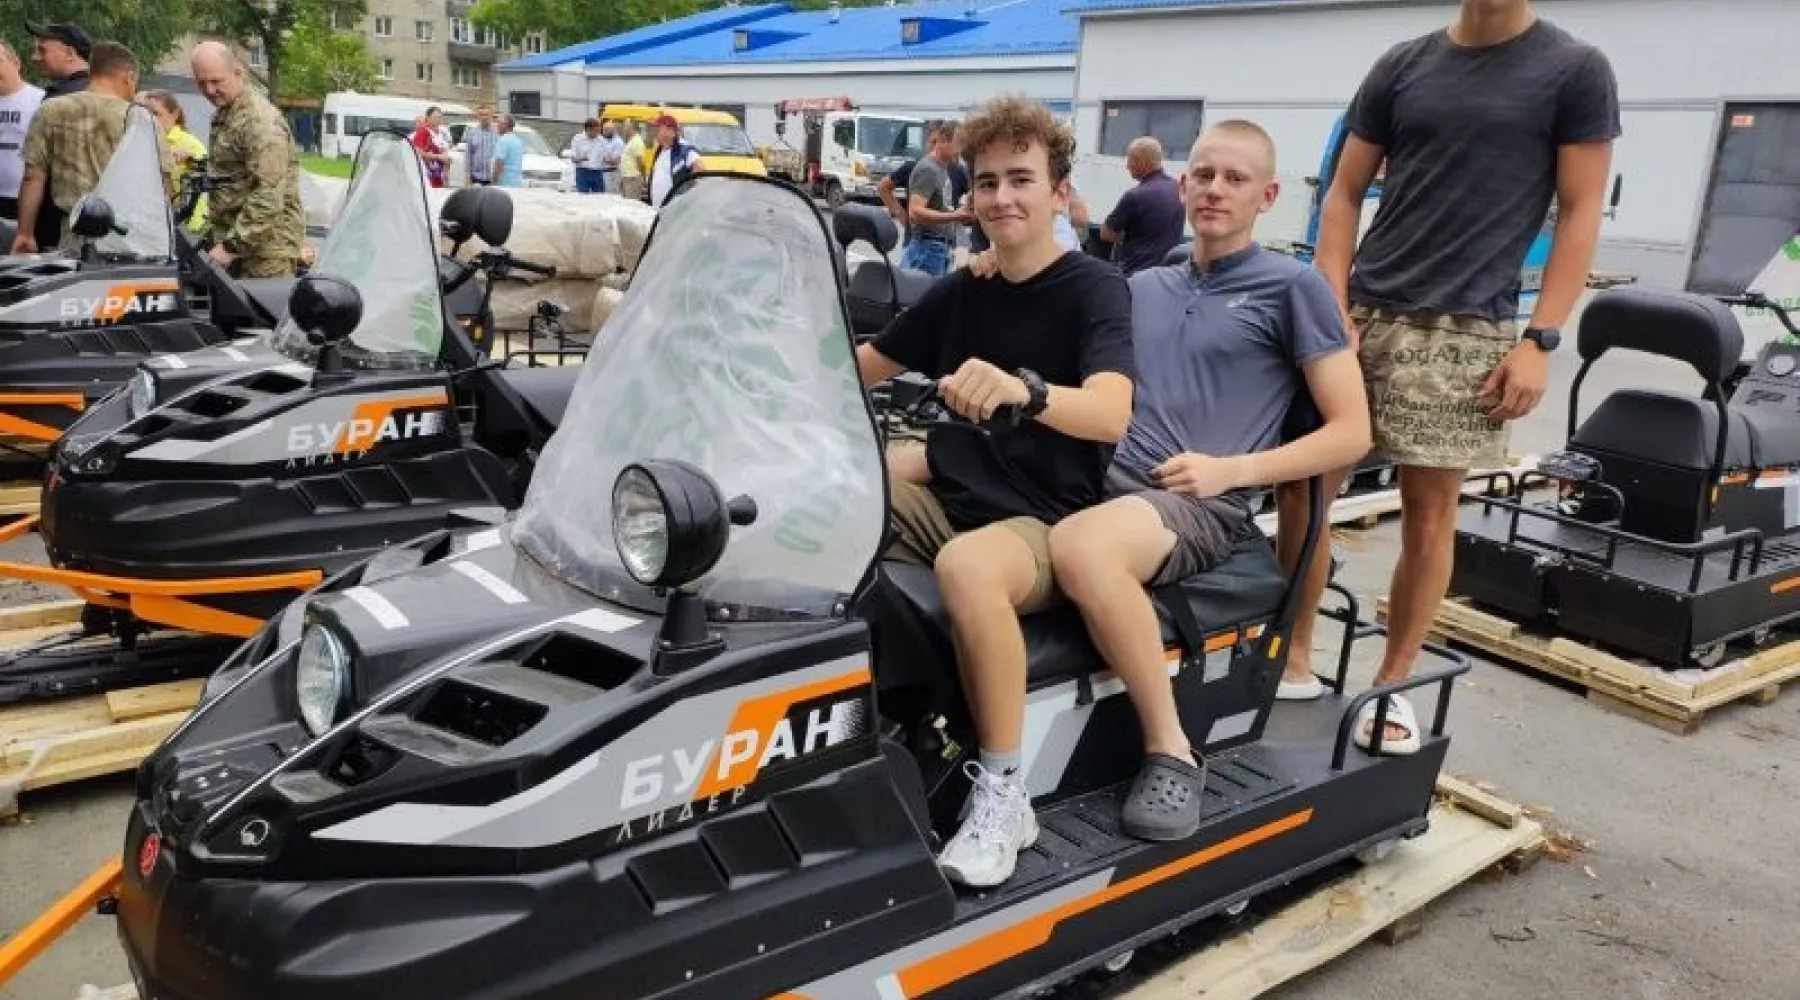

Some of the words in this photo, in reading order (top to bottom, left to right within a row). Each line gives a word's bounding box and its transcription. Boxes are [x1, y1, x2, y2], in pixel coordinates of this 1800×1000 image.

[60, 293, 175, 317] БУРАН
[287, 410, 443, 452] БУРАН
[620, 698, 860, 810] БУРАН
[616, 785, 746, 843] ЛИДЕР
